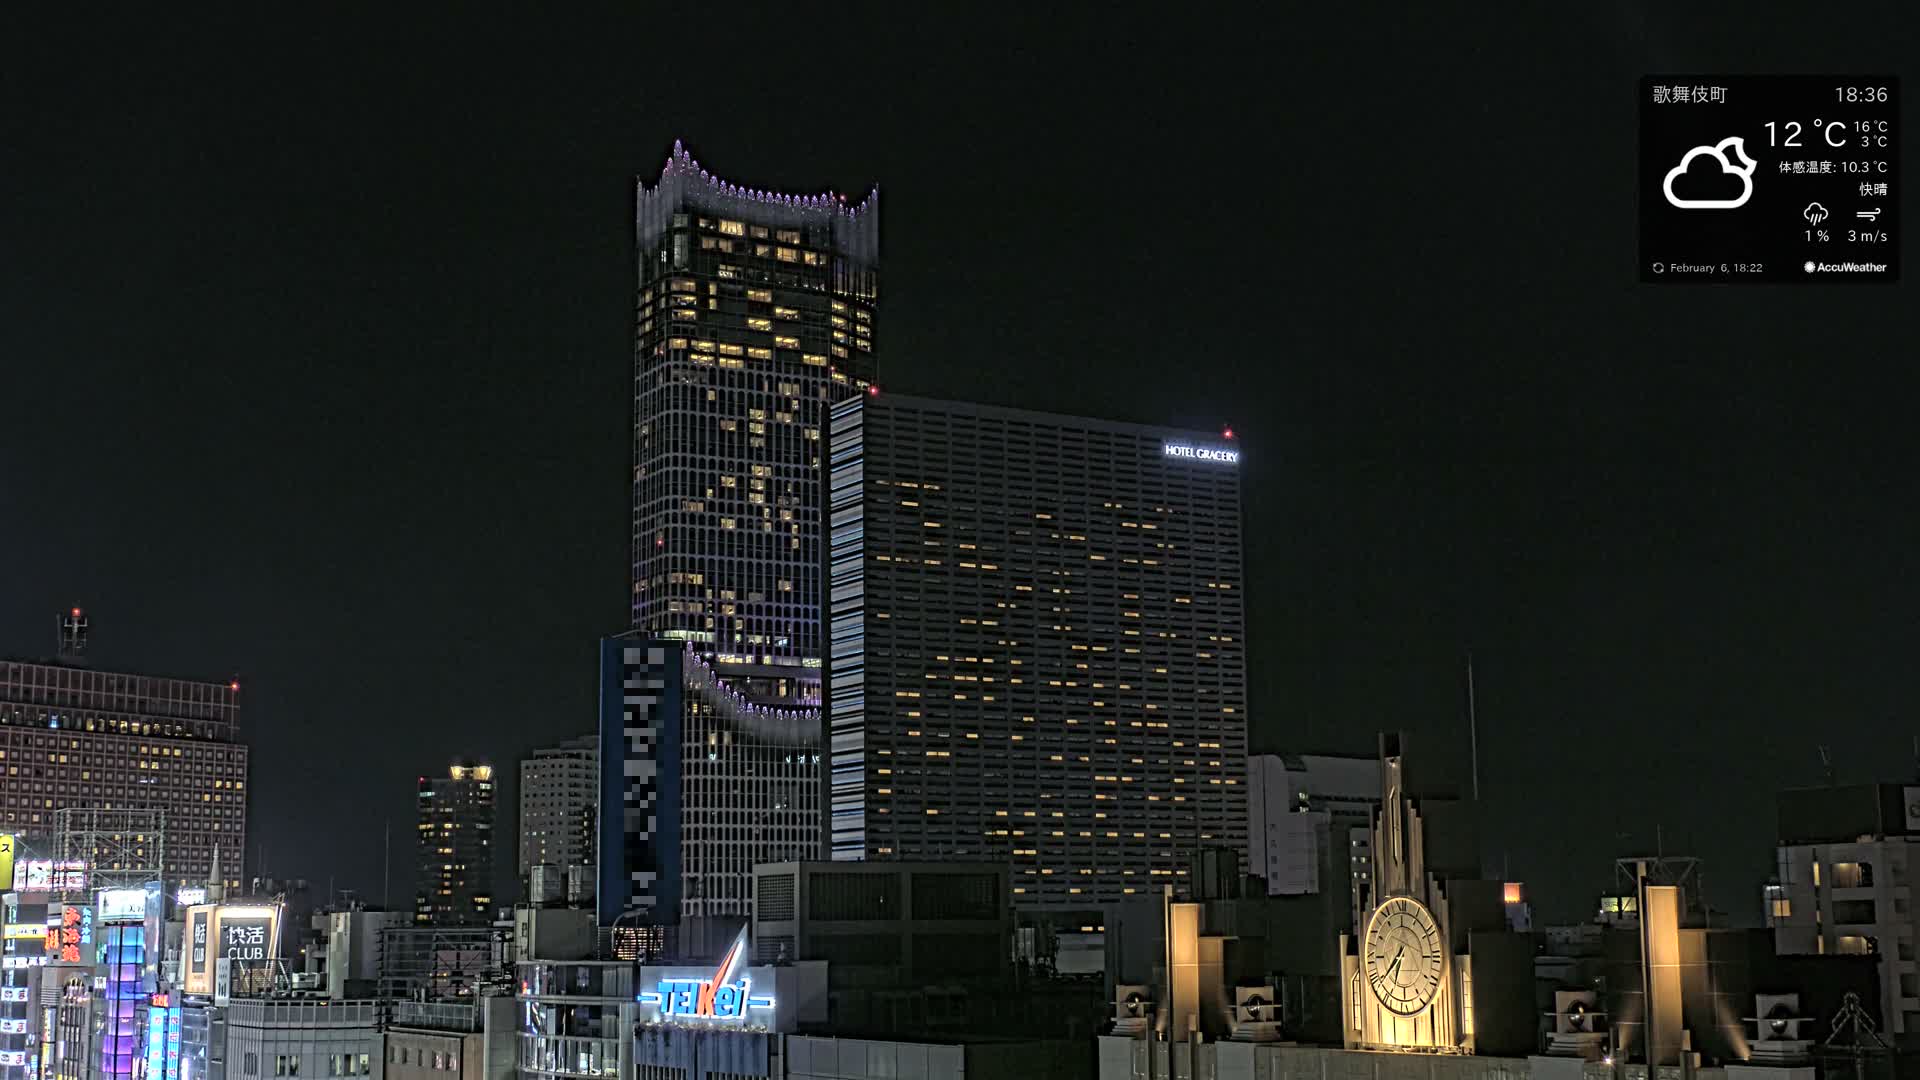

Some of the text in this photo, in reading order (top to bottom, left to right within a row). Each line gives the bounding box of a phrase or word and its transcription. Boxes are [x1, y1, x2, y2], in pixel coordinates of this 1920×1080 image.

[1165, 444, 1238, 462] HOTEL GRACERY
[228, 926, 265, 945] 快活
[228, 947, 263, 960] CLUB
